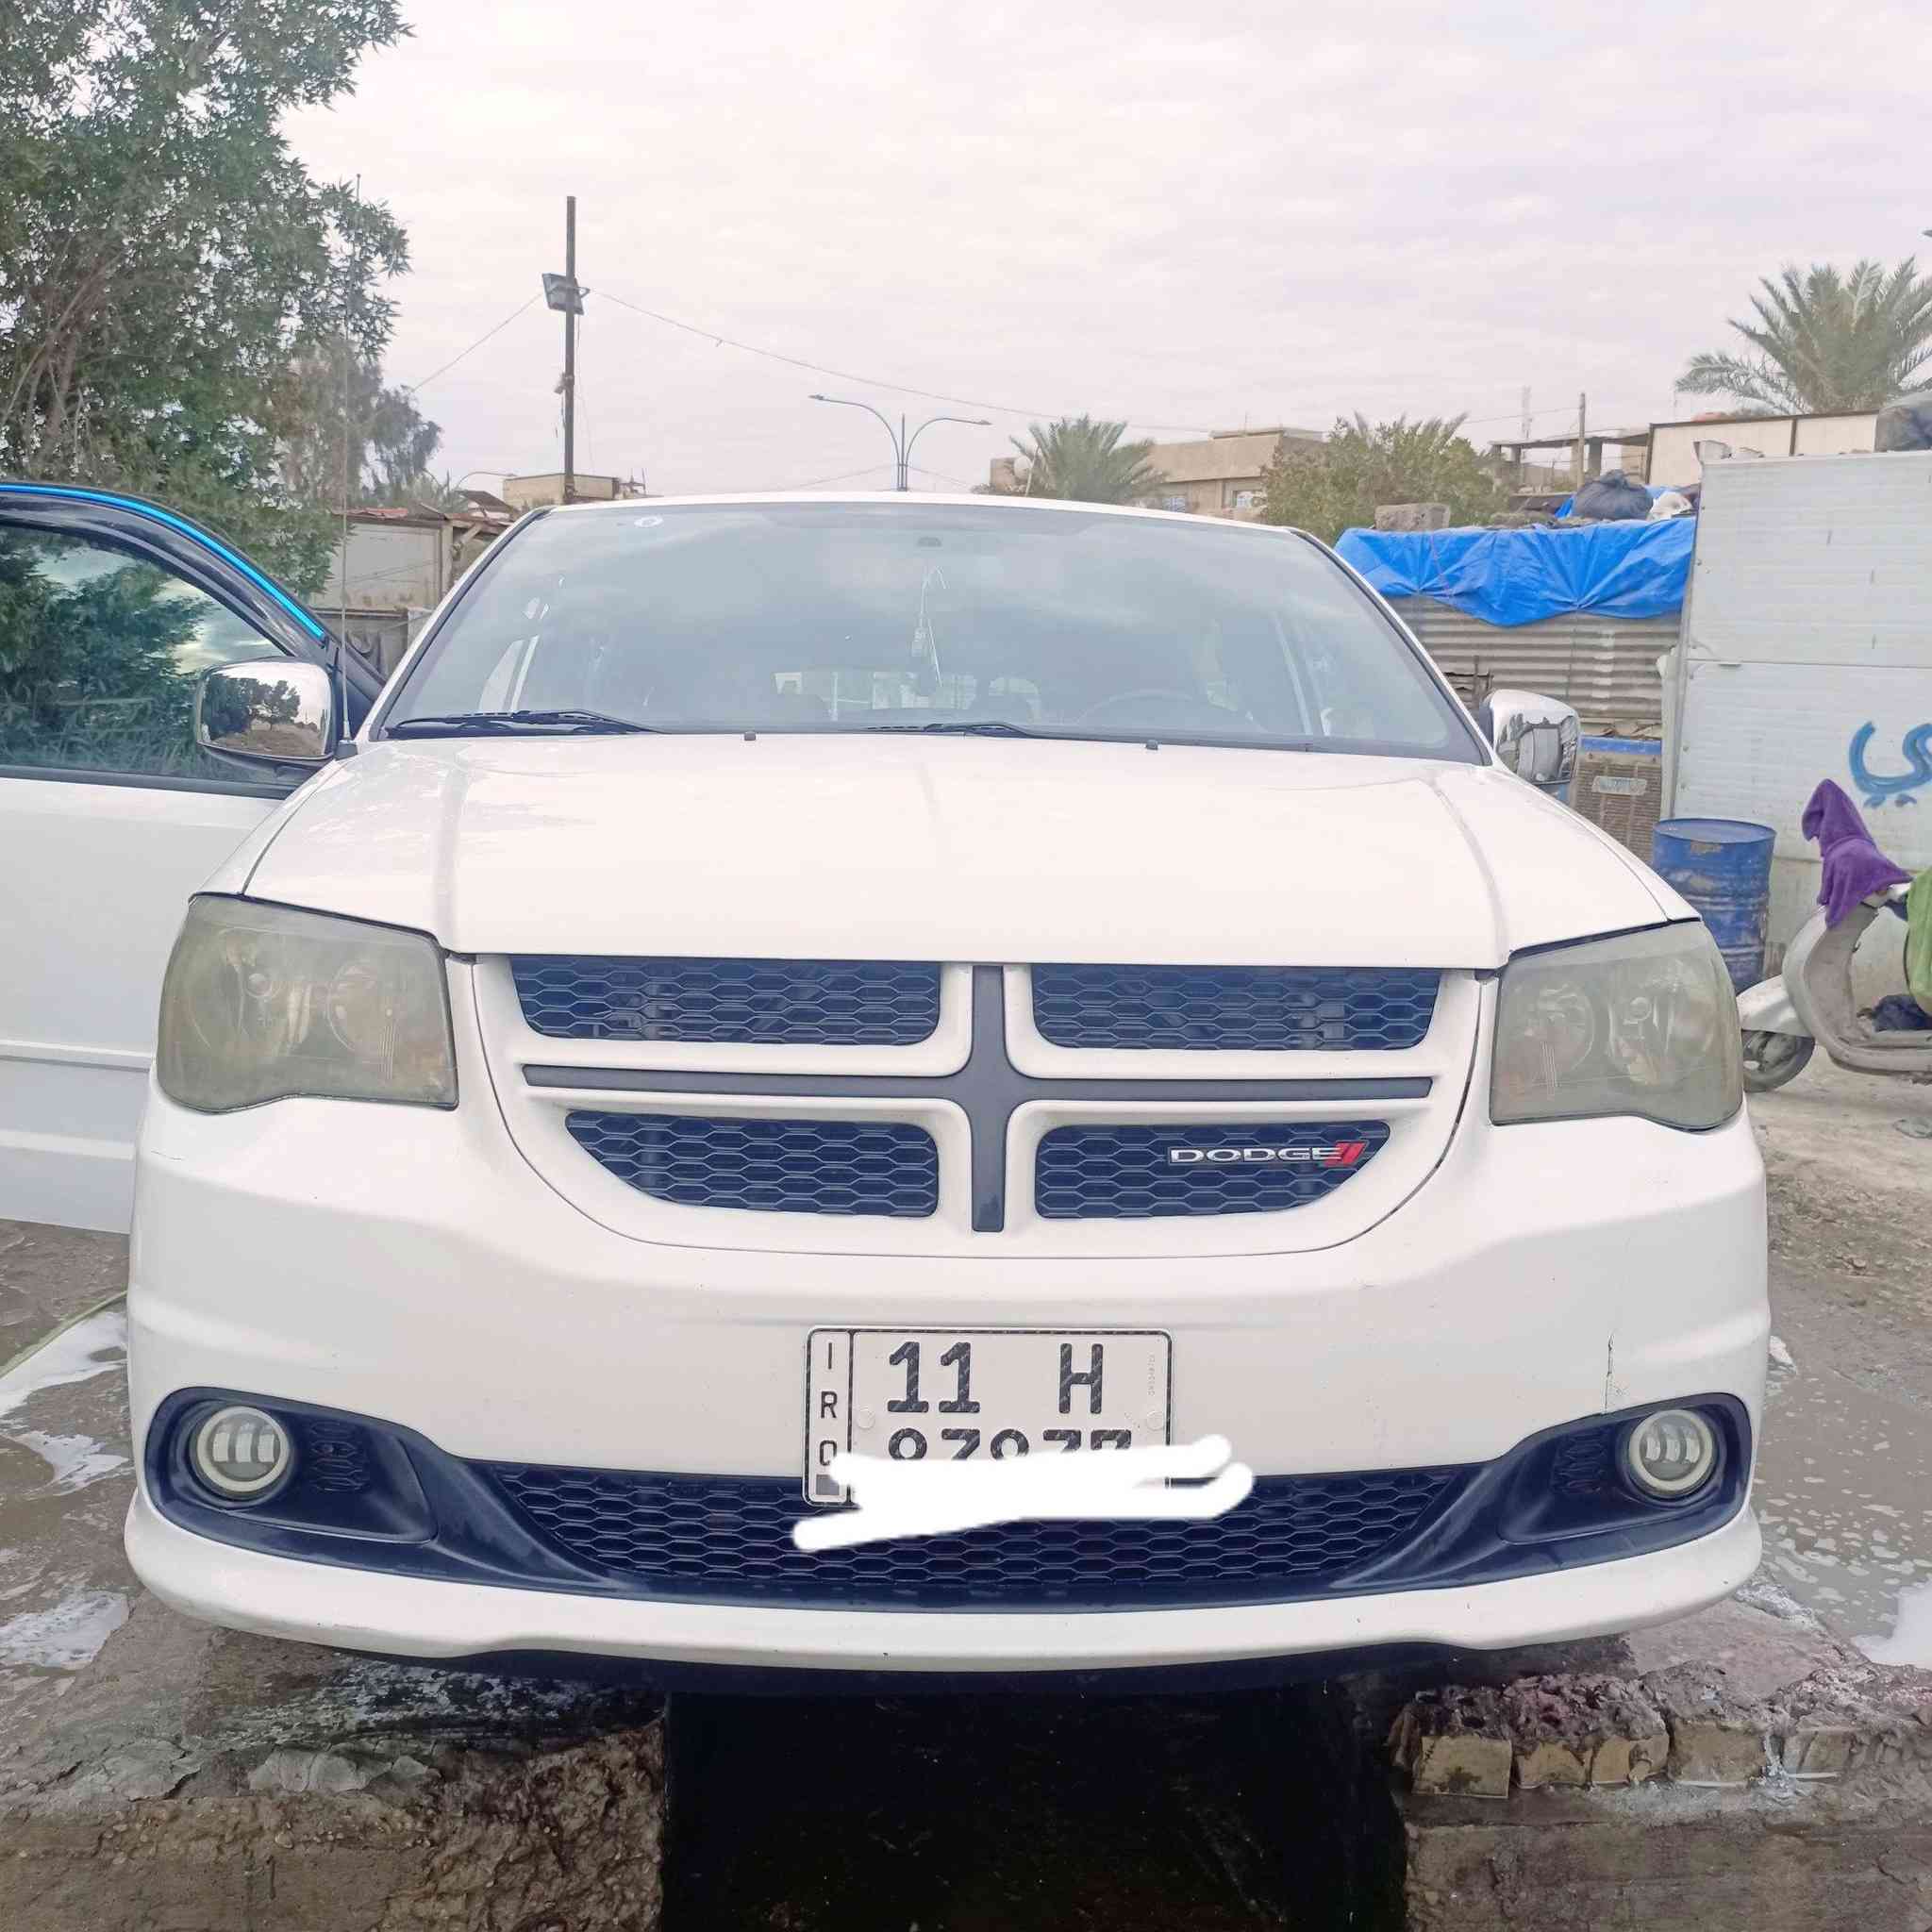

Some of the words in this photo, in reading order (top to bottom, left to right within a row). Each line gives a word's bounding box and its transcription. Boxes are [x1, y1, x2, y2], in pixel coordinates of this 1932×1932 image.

[1170, 1146, 1341, 1164] DODGE
[887, 1341, 980, 1414] 11
[1058, 1341, 1104, 1414] H
